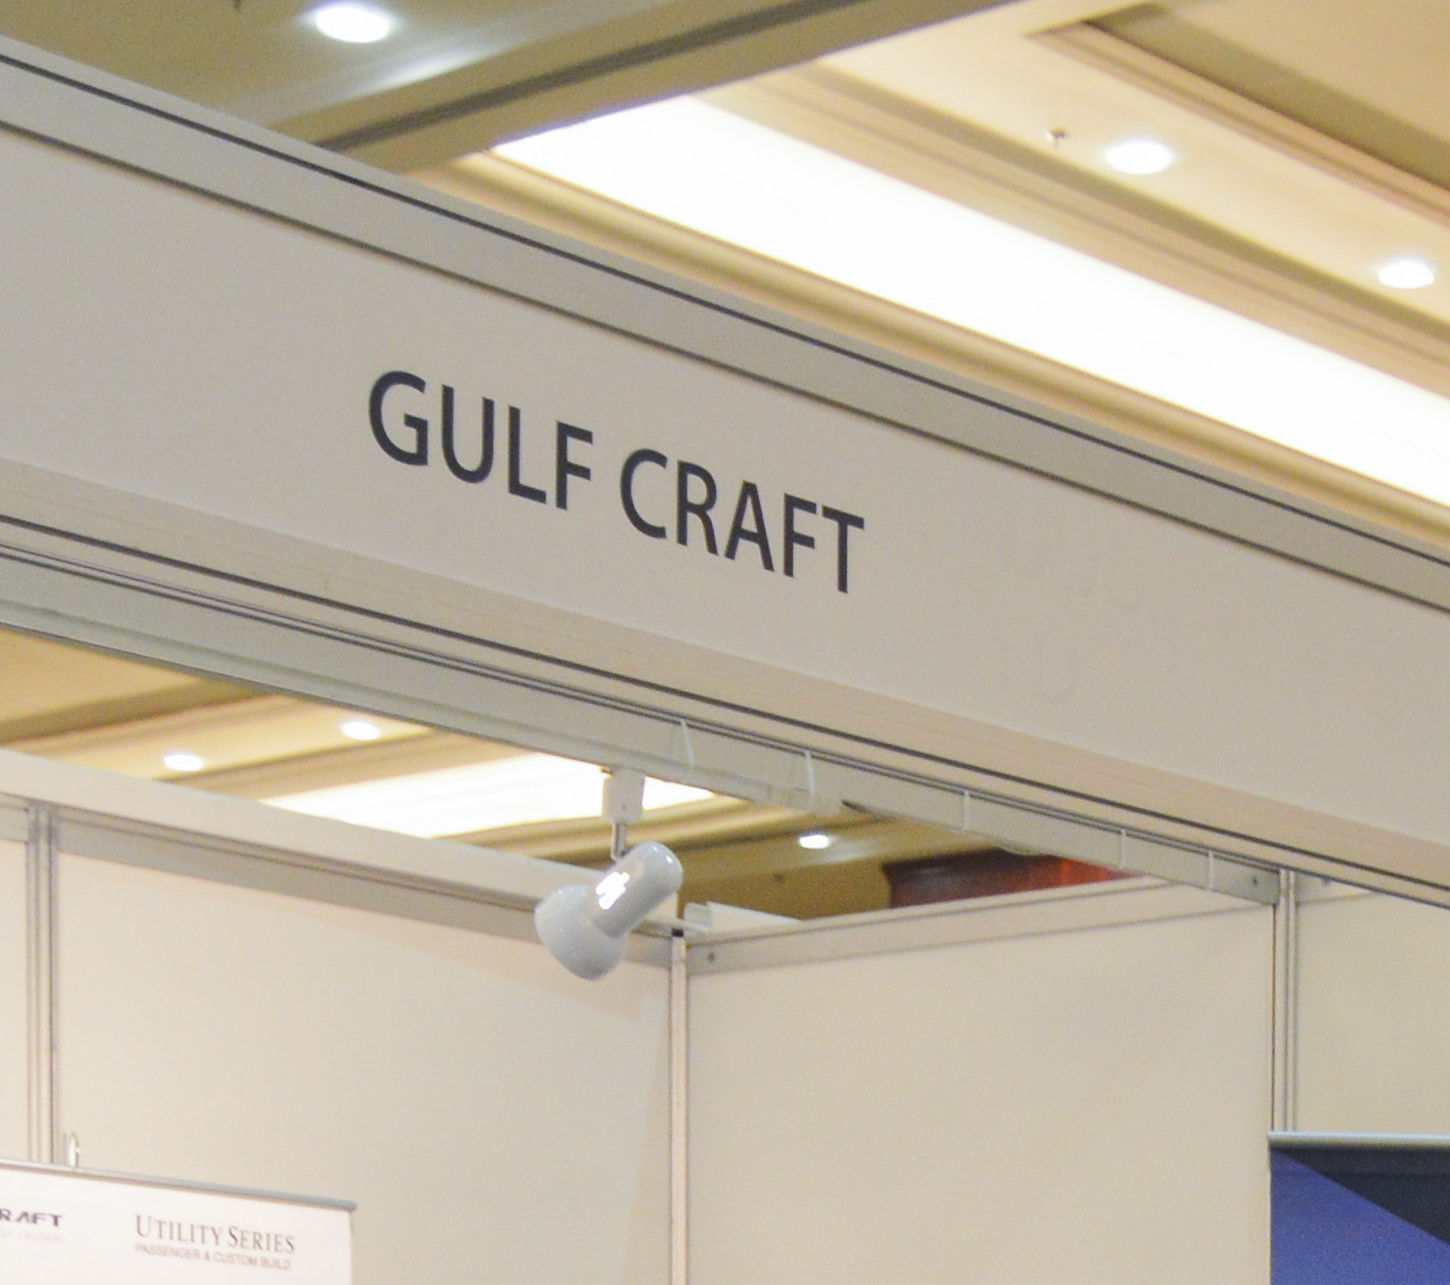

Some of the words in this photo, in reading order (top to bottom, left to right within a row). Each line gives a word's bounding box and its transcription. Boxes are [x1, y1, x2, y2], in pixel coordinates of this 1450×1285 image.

[367, 369, 595, 511] GULF
[619, 447, 866, 595] CRAFT
[134, 1214, 224, 1246] UTILITY
[228, 1224, 296, 1255] SERIES
